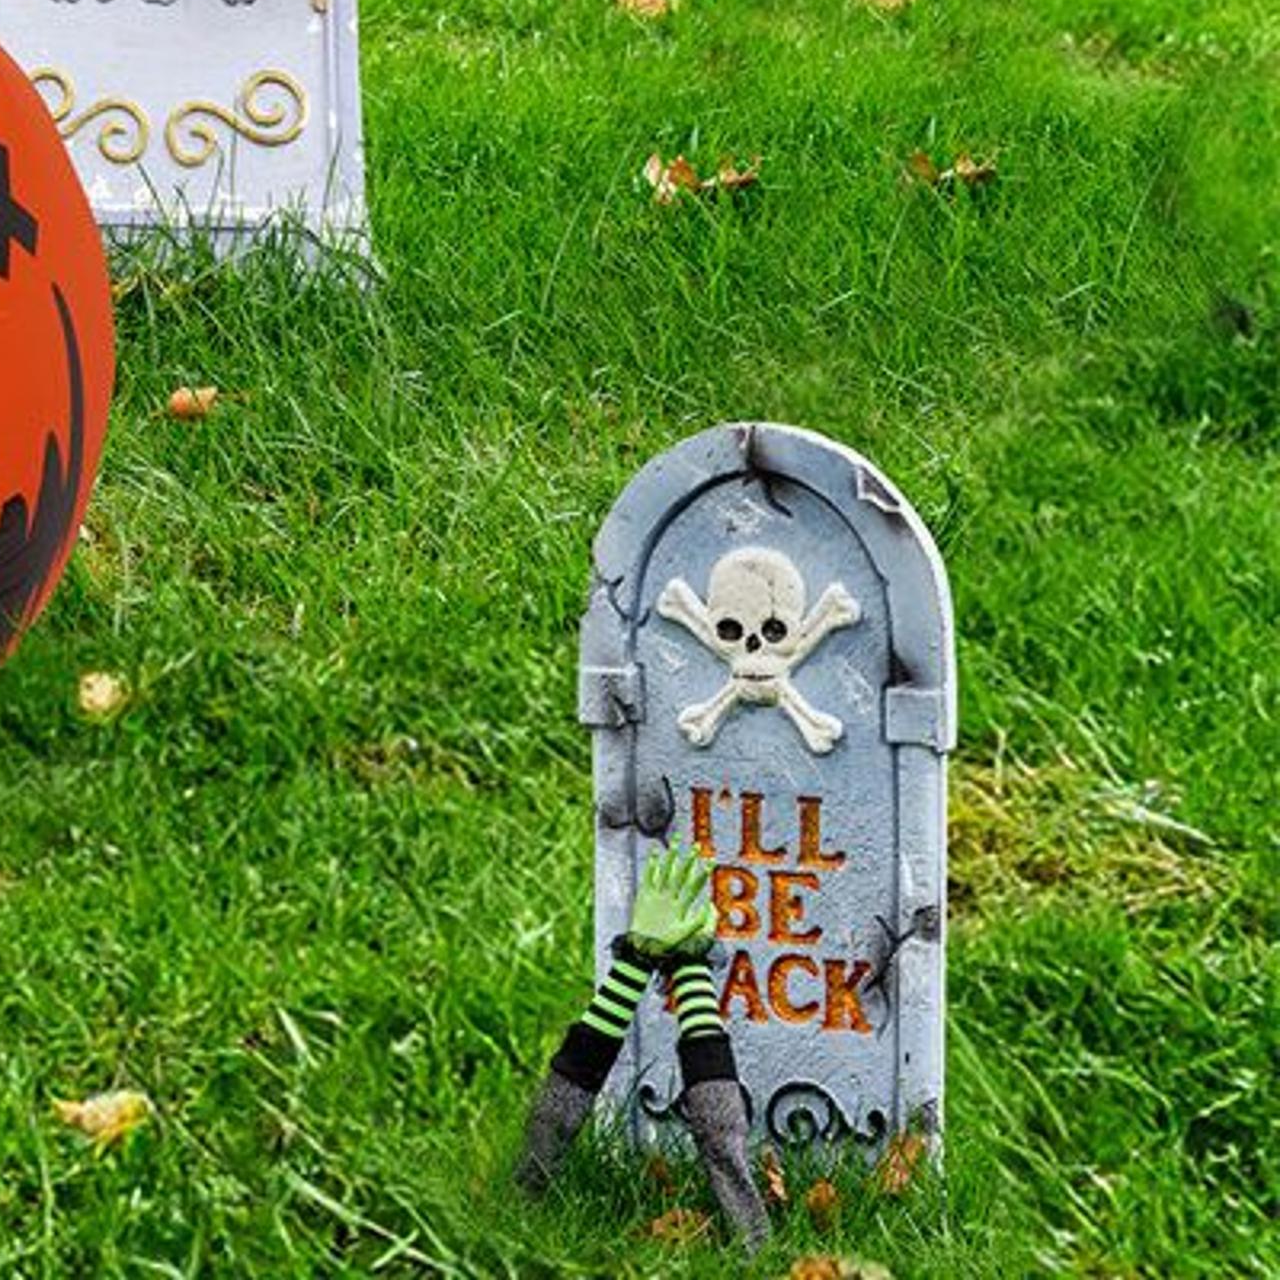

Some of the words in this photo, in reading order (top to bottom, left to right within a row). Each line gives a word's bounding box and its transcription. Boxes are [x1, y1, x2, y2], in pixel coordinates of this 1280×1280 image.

[690, 785, 848, 871] I'LL
[711, 864, 824, 945] BE
[663, 949, 873, 1034] ACK
